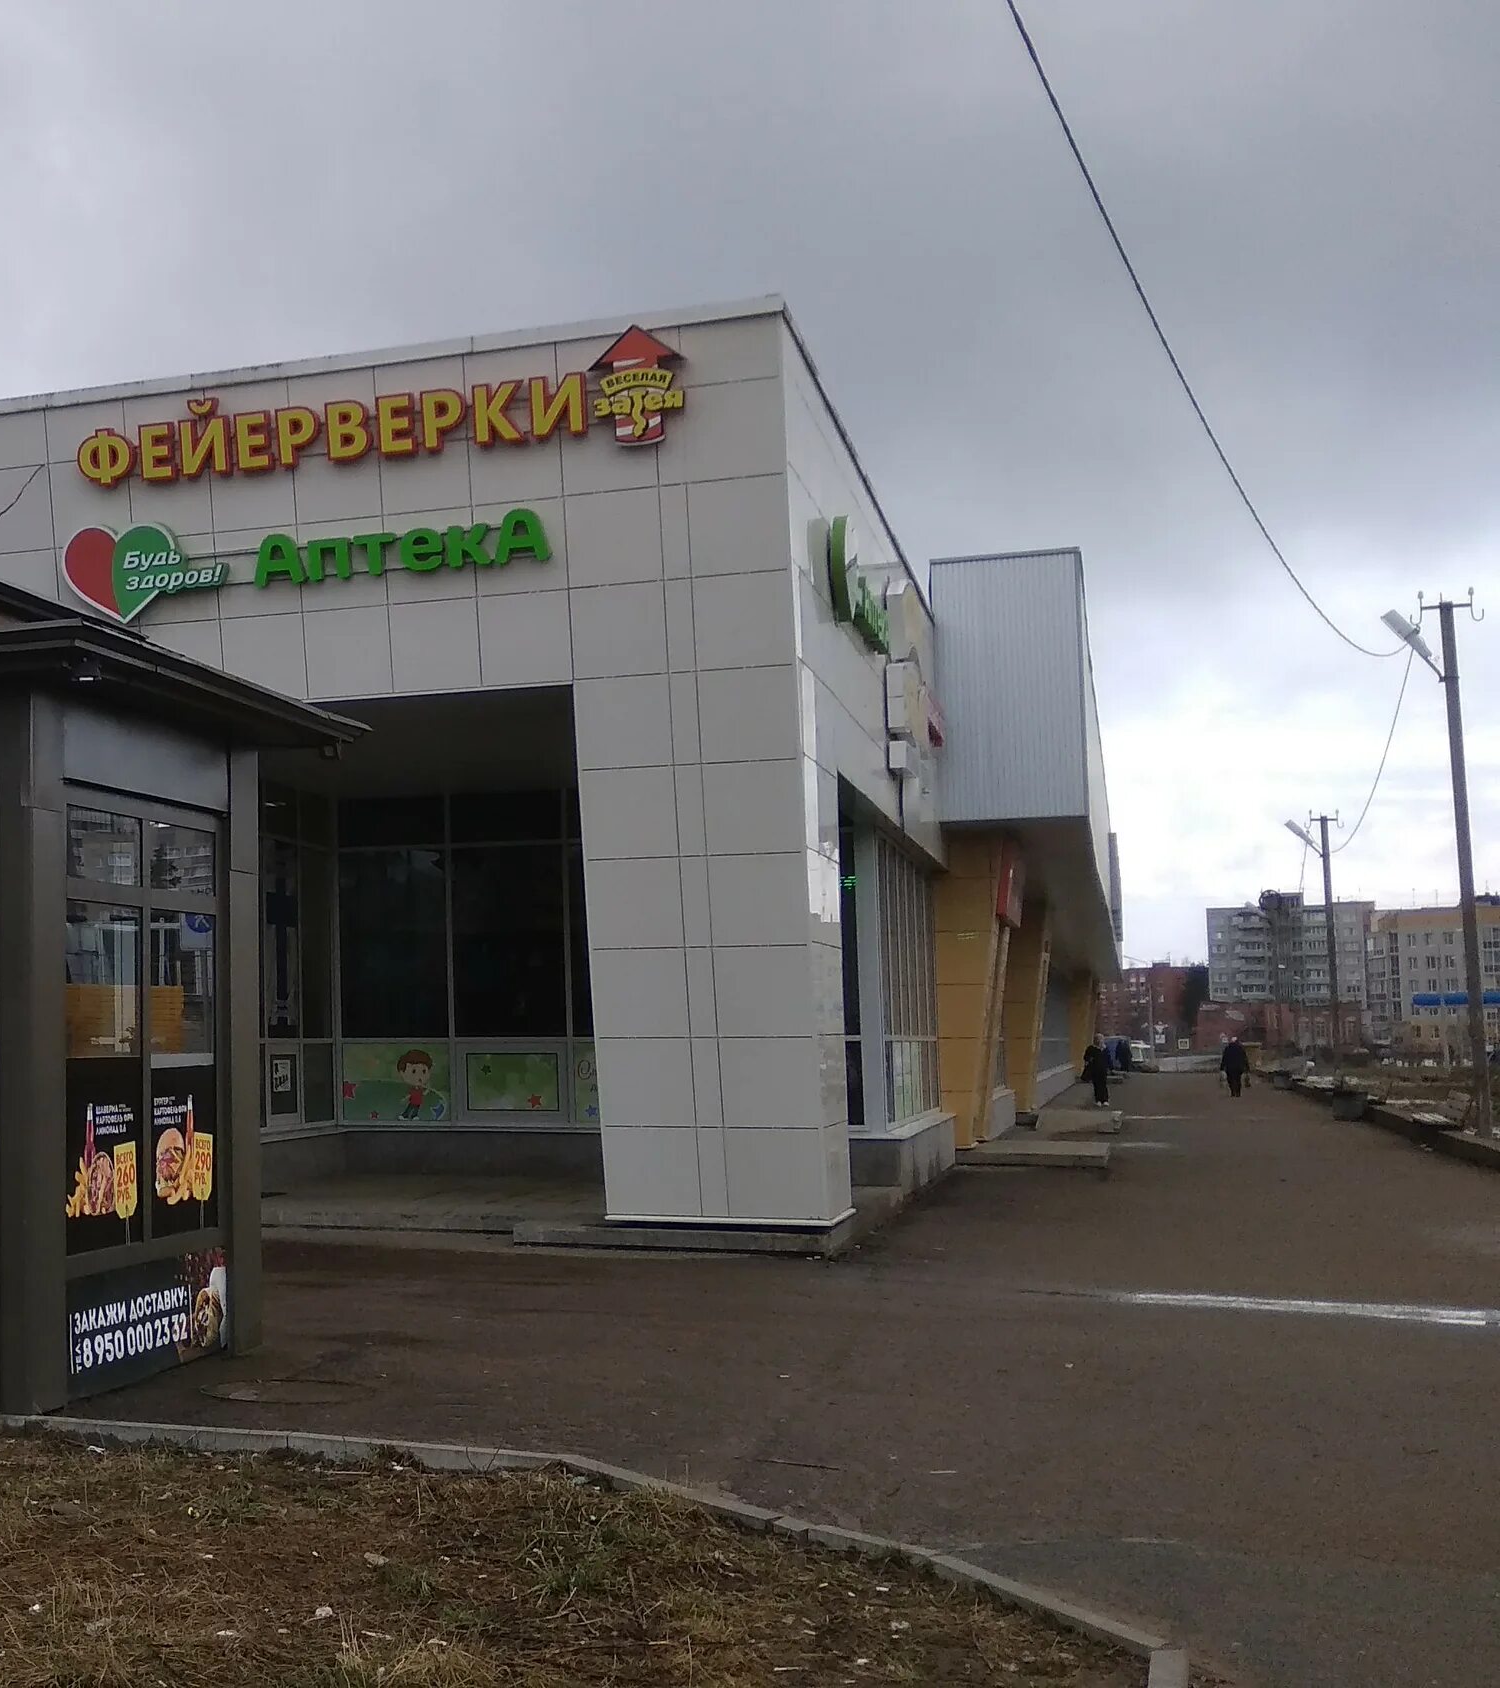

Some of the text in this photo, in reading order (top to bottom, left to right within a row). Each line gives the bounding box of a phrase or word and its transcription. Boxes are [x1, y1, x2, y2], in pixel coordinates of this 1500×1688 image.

[605, 371, 667, 388] ВЕСЕЛАЯ
[76, 372, 588, 488] ФЕЙЕРВЕРКИ
[123, 551, 180, 571] Будь
[125, 564, 222, 590] здоров!
[195, 1138, 211, 1151] ВСЕГО
[115, 1150, 134, 1165] ВСЕГО
[195, 1151, 211, 1172] 290
[116, 1163, 135, 1188] 260
[74, 1286, 189, 1335] ЗАКАЖИ ДОСТАВКУ:
